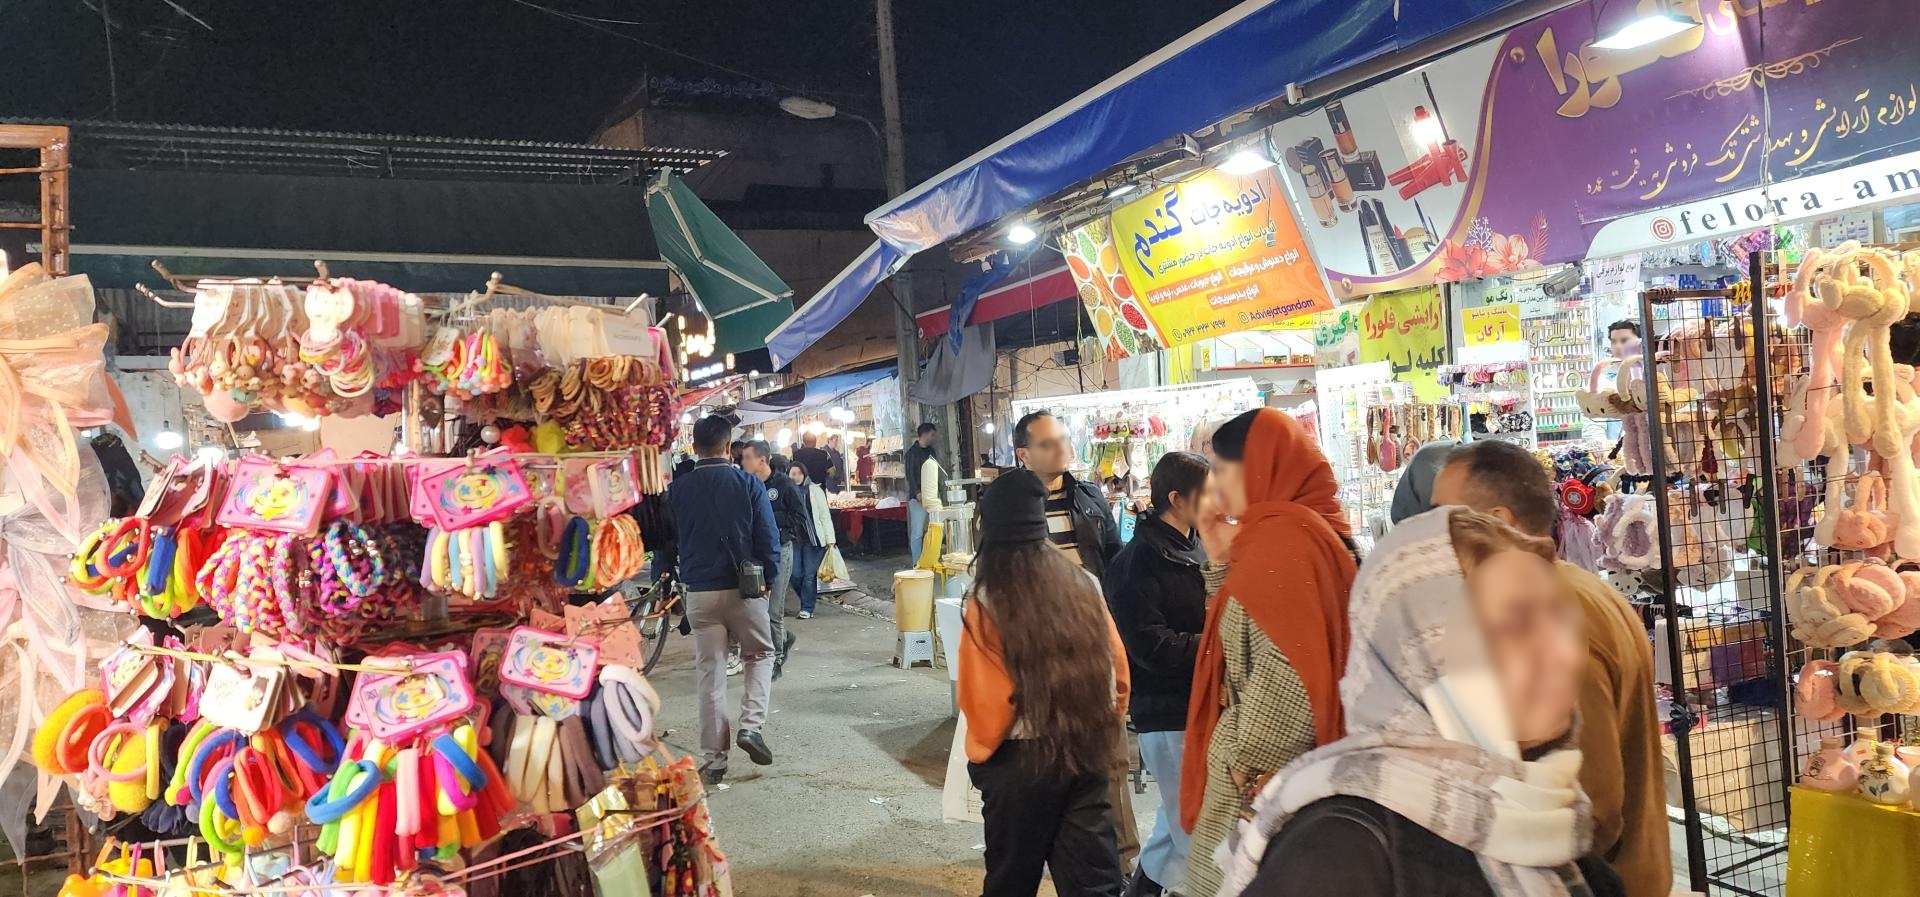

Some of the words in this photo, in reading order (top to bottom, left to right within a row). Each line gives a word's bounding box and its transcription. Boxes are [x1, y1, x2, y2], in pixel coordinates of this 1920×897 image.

[1877, 83, 1918, 125] لوازم
[1705, 113, 1749, 166] تک
[1785, 89, 1870, 167] آرایشی
[1801, 129, 1808, 143] و
[1609, 147, 1647, 190] قیمت
[1640, 143, 1697, 200] فروشی
[1223, 180, 1267, 216] ادویه
[1191, 202, 1220, 226] جات
[1135, 187, 1182, 279] گندم
[1157, 258, 1178, 274] مشتری
[1284, 248, 1300, 266] انواع
[1210, 271, 1224, 287] انواع
[1246, 284, 1260, 300] انواع
[1249, 298, 1316, 321] Adviejatgandom
[1485, 295, 1494, 306] مو
[1496, 289, 1513, 303] رنگ
[1364, 307, 1396, 340] فلورا
[1397, 293, 1443, 334] آرایشی
